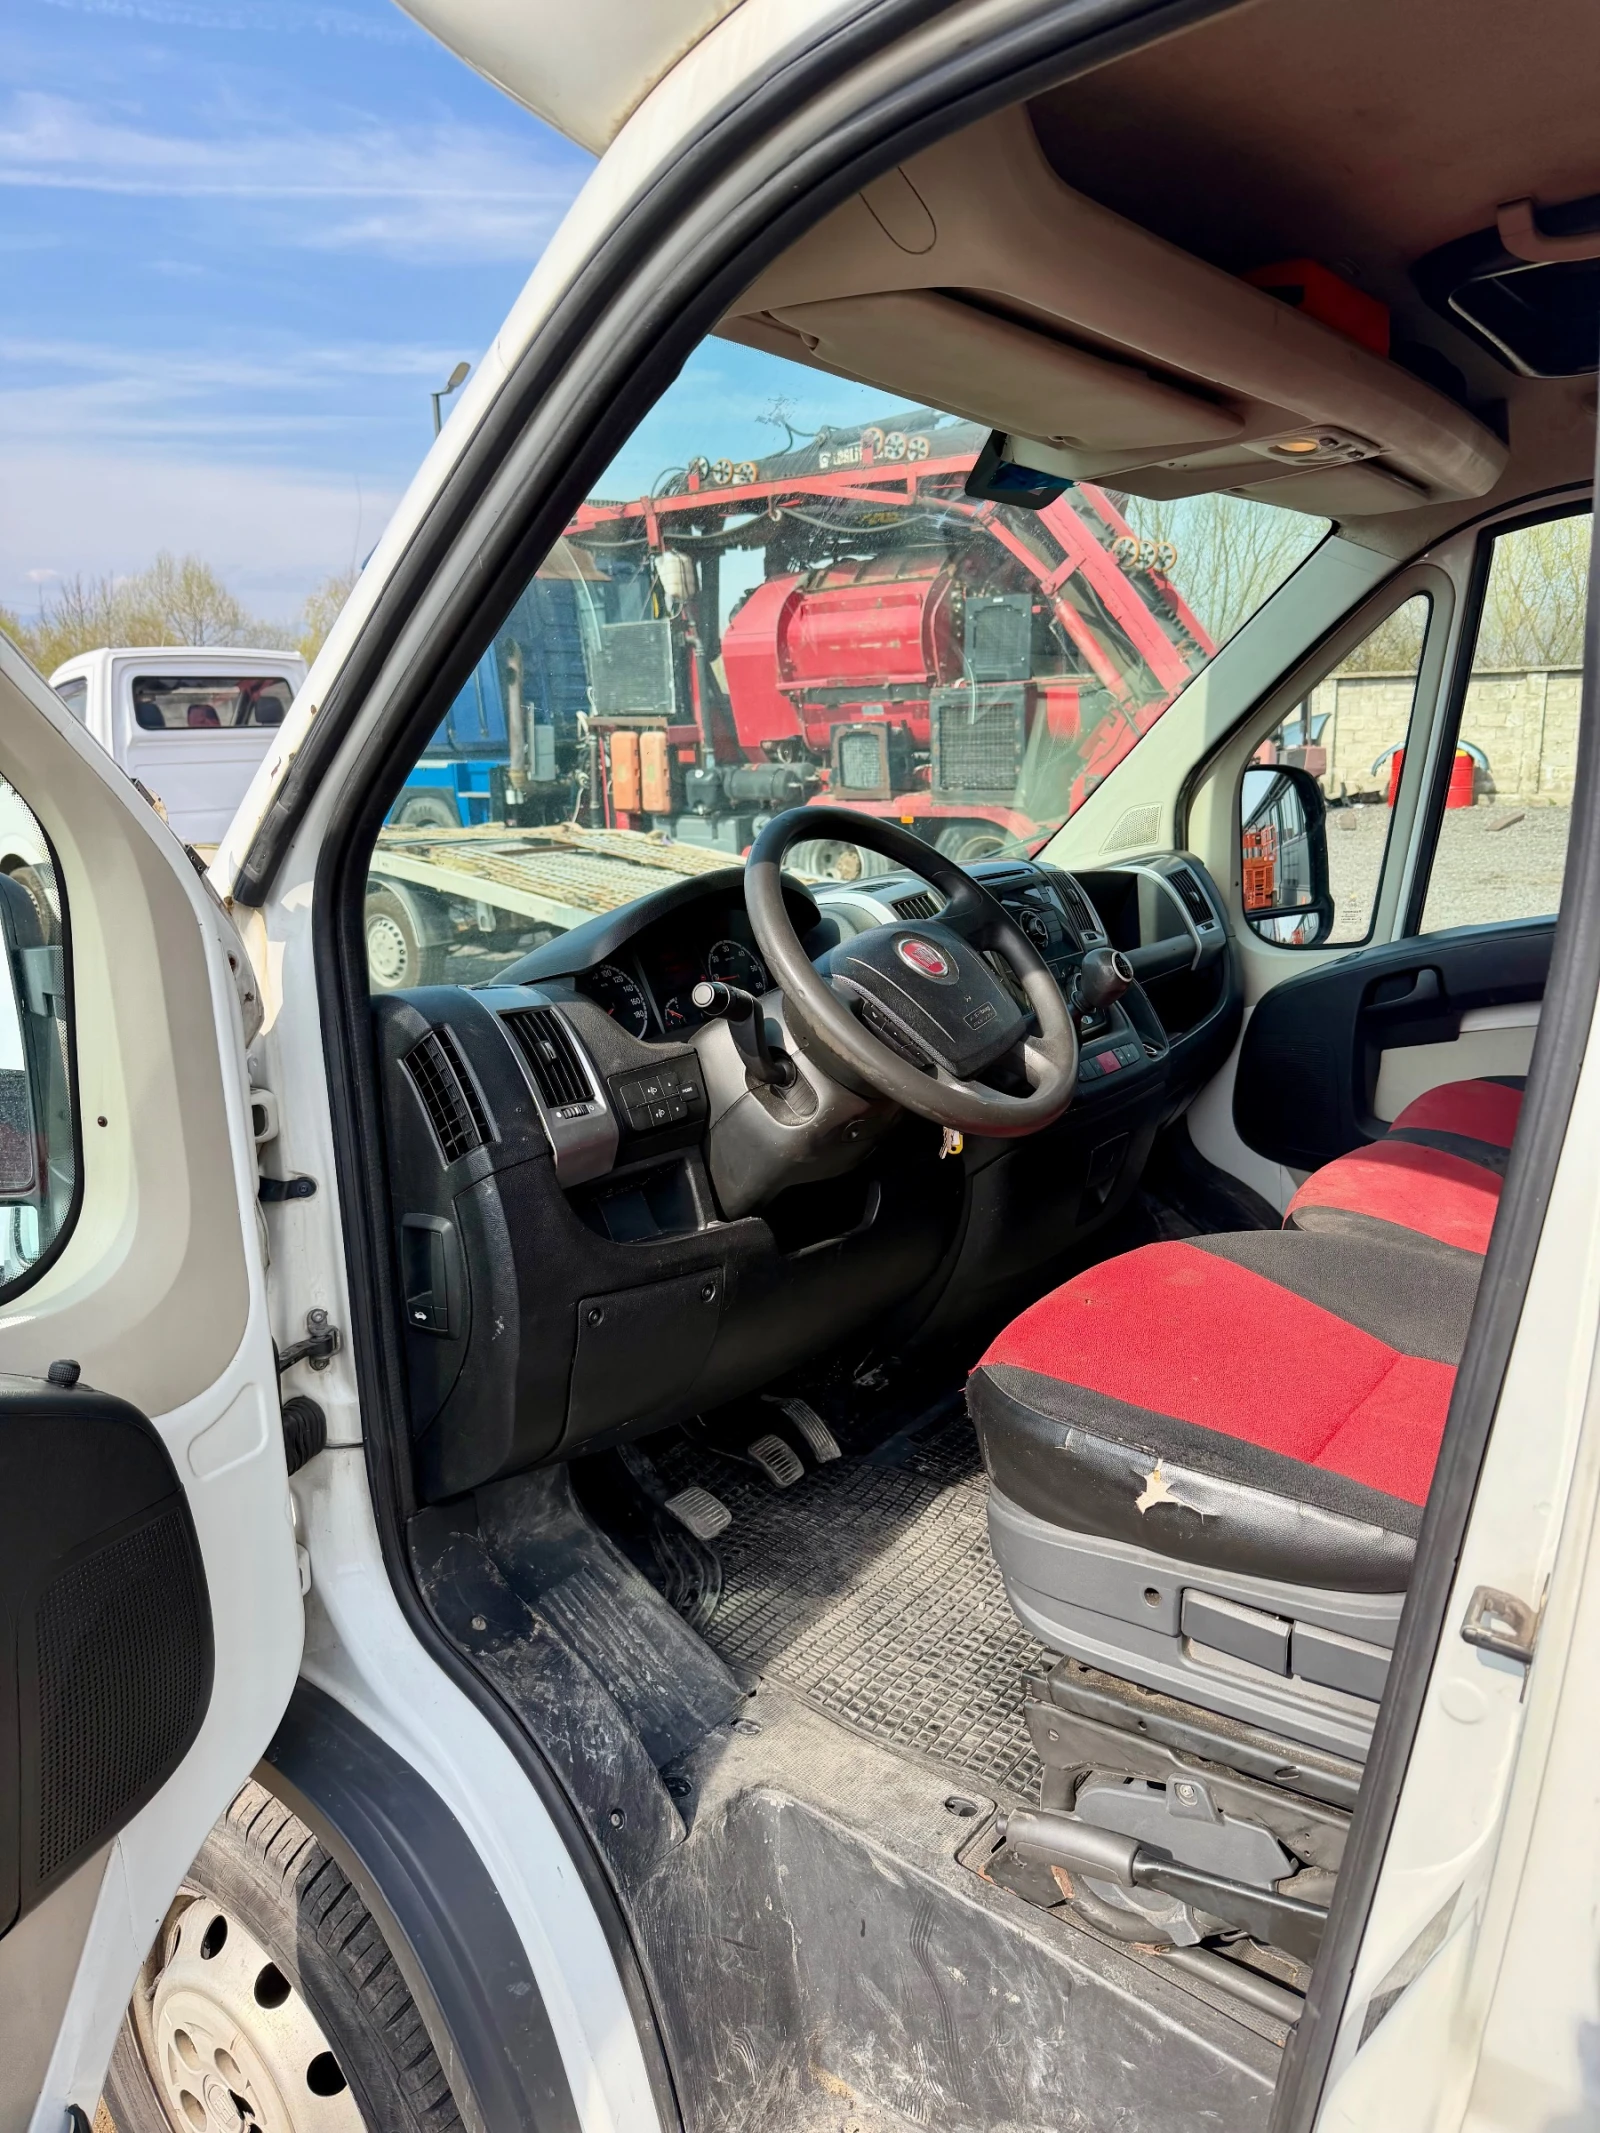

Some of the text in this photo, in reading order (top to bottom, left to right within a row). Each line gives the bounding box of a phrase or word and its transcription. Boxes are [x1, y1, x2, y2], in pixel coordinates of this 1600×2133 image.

[600, 969, 613, 978] 100
[612, 975, 624, 984] 120
[622, 984, 634, 993] 140
[630, 997, 641, 1006] 160
[633, 1009, 646, 1019] 180
